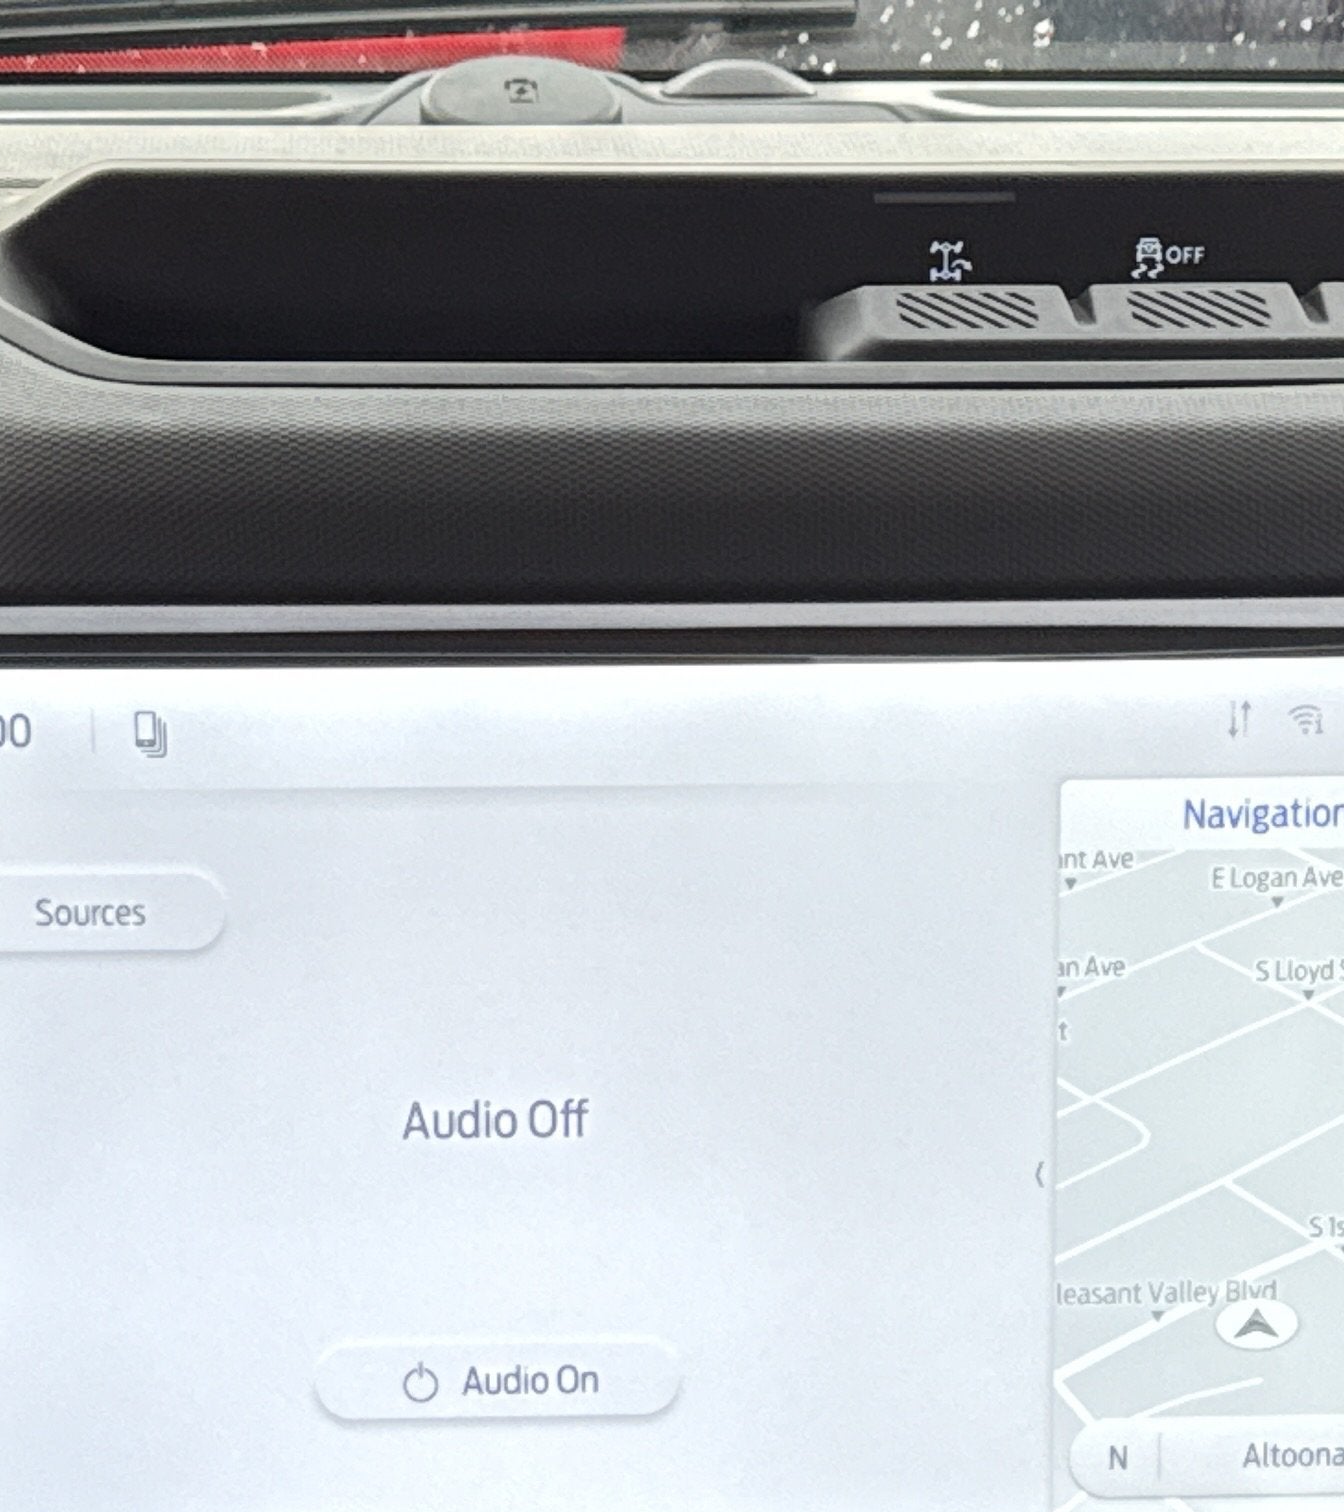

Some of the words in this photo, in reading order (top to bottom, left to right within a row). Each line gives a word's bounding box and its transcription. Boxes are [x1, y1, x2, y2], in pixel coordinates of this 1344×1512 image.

[1166, 245, 1205, 263] OFF
[1092, 850, 1134, 869] Ave
[1212, 868, 1225, 888] E
[1231, 866, 1298, 890] Logan
[1302, 866, 1344, 888] Ave
[35, 898, 147, 928] Sources
[1084, 956, 1126, 977] Ave
[1256, 959, 1270, 982] S
[1276, 957, 1336, 984] Lloyd
[402, 1100, 519, 1140] Audio
[528, 1098, 590, 1138] Off
[1309, 1216, 1325, 1238] S
[1147, 1279, 1219, 1307] Valley
[1225, 1279, 1278, 1302] Blvd
[462, 1365, 549, 1396] Audio
[557, 1364, 600, 1394] On
[1109, 1447, 1128, 1470] N
